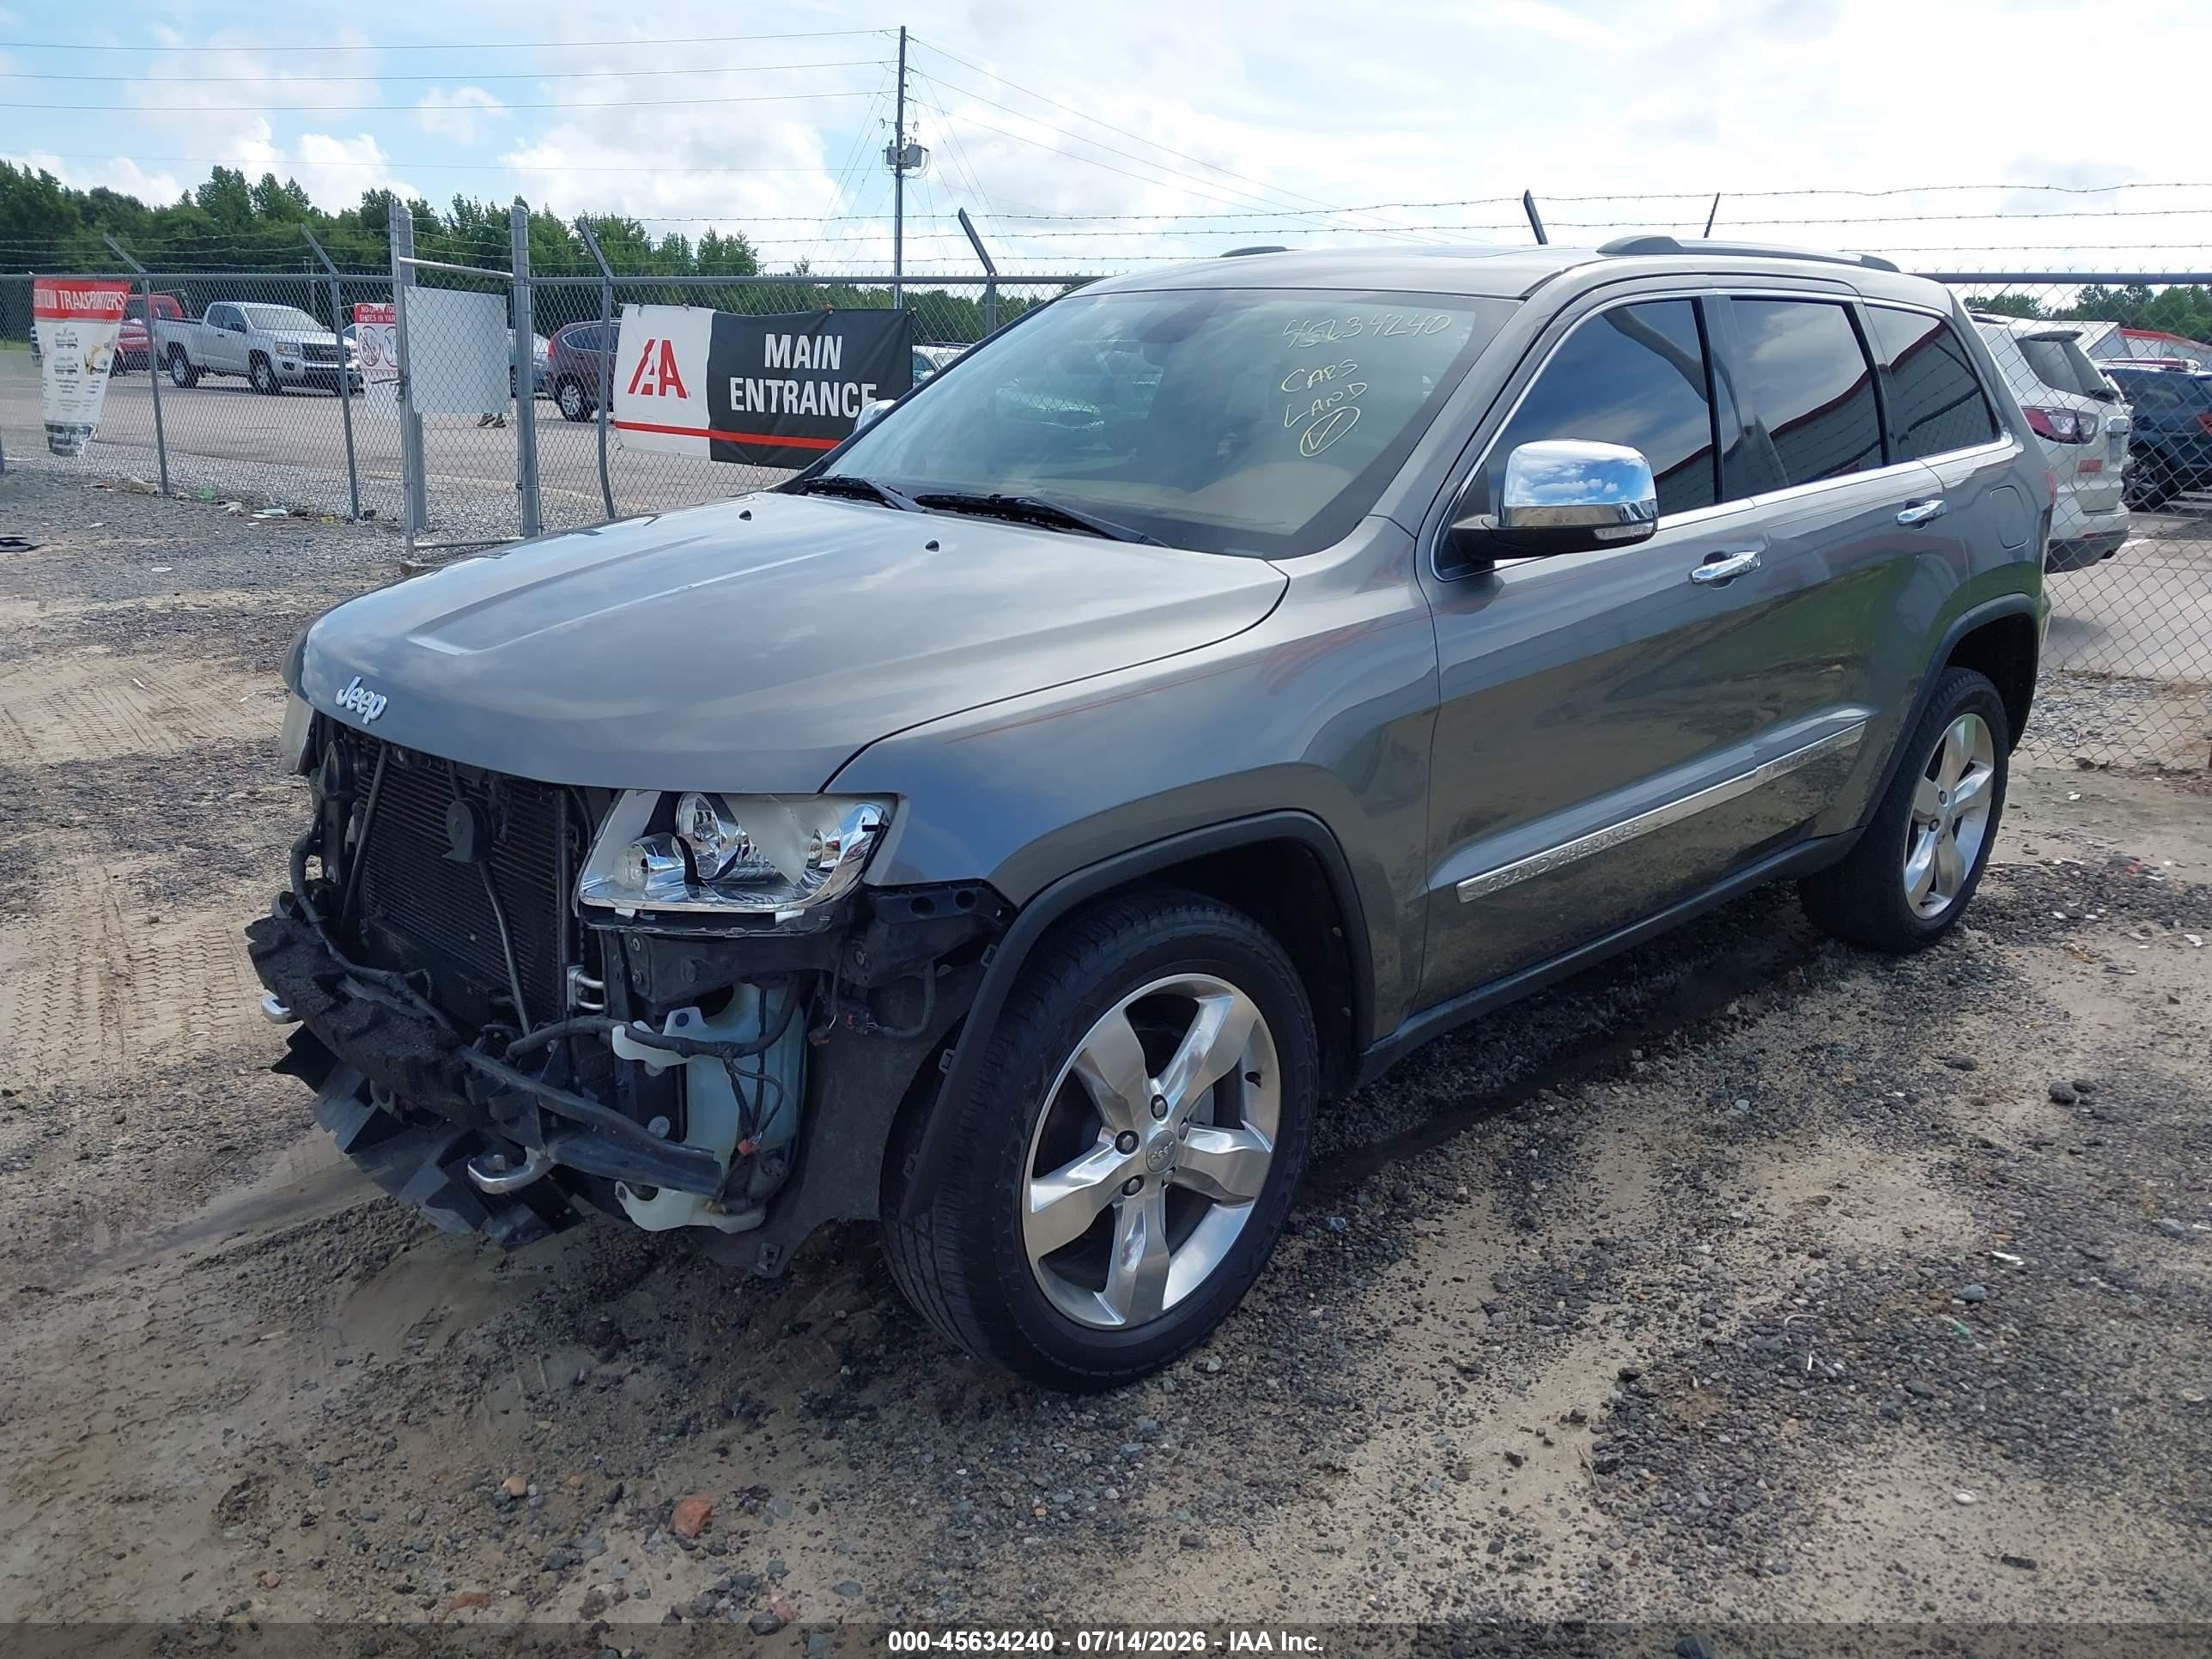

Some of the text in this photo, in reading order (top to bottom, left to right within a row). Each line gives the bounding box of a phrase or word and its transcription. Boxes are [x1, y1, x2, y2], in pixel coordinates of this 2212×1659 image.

[361, 305, 369, 313] NO
[1282, 313, 1451, 349] 45634240
[763, 333, 843, 370] MAIN
[1280, 358, 1358, 392] CARS
[729, 376, 878, 418] ENTRANCE
[1284, 381, 1368, 428] LAND
[335, 676, 387, 726] Jeep
[1486, 822, 1642, 892] GRAND CHEROKEE
